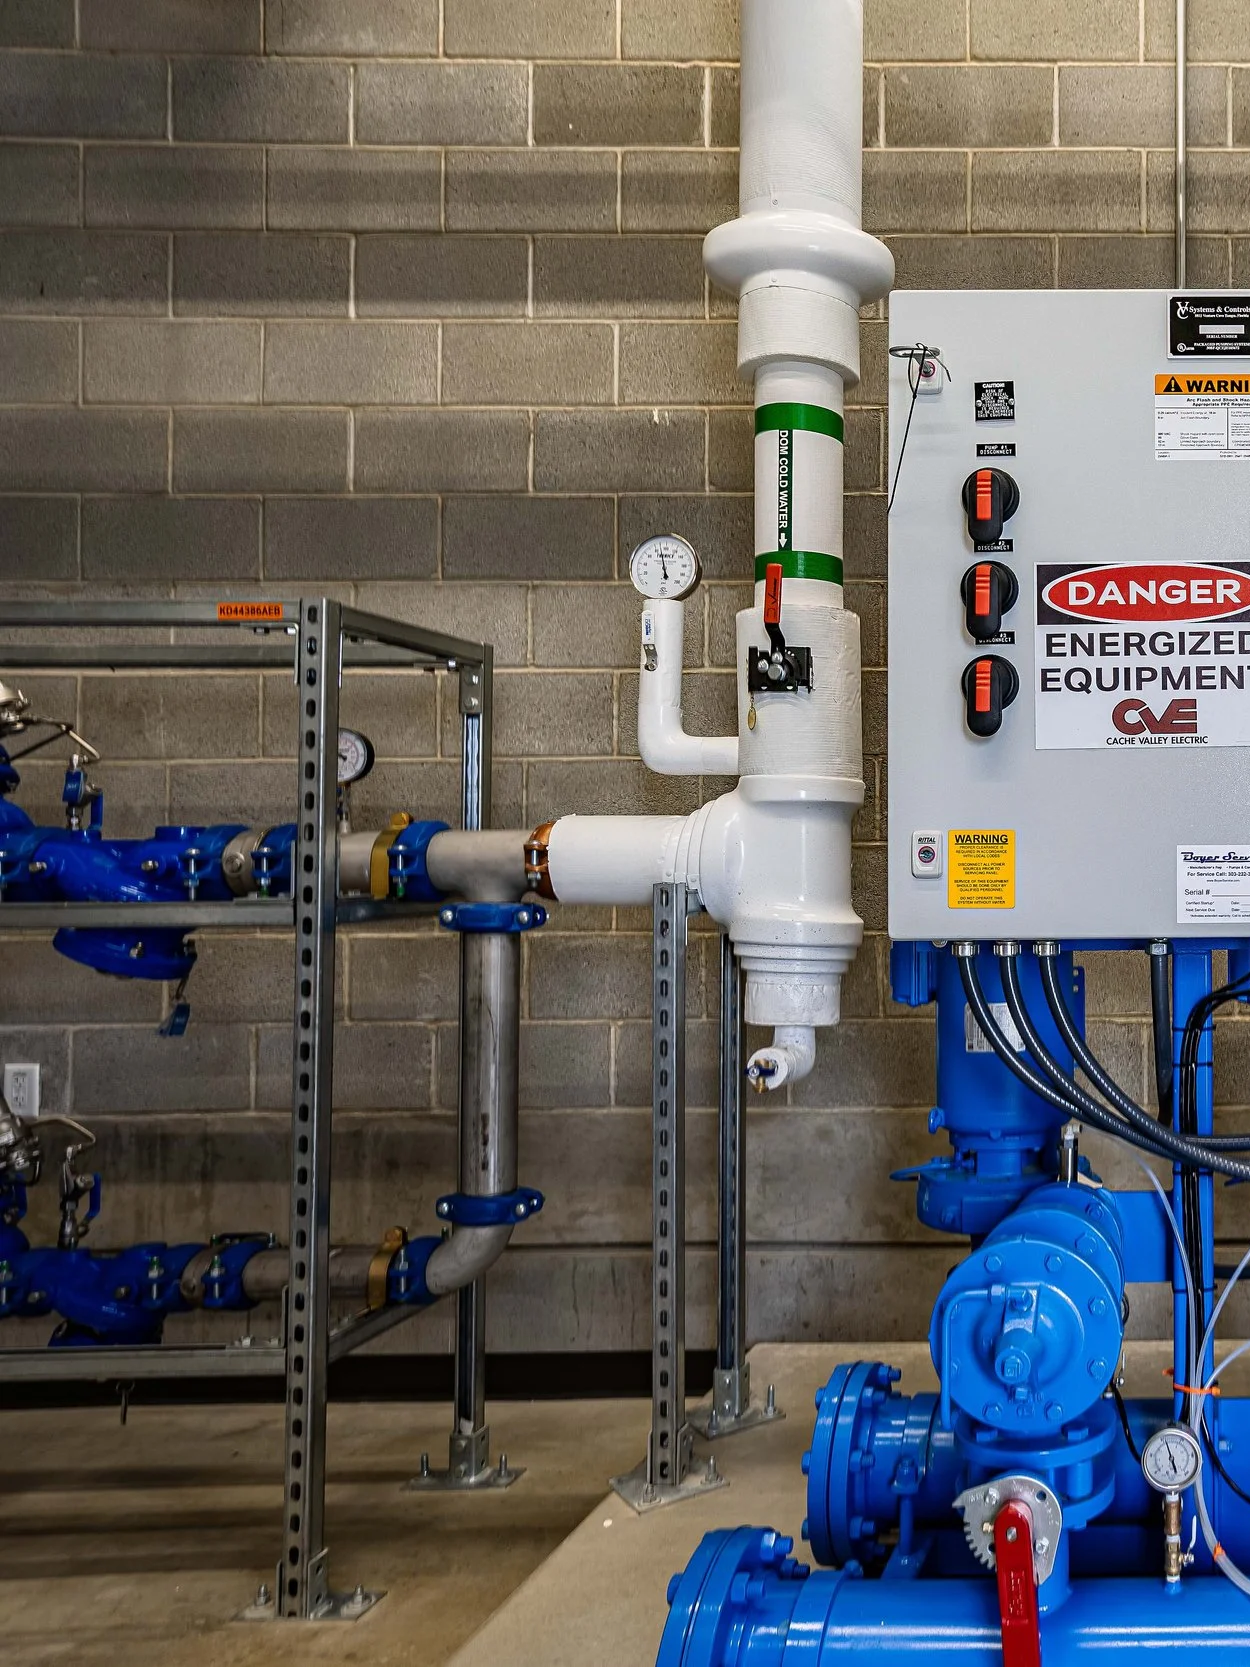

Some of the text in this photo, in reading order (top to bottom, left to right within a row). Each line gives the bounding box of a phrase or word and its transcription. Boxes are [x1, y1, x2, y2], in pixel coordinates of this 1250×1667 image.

[1189, 306, 1215, 314] Systems
[779, 430, 789, 529] DOM COLD WATER
[1068, 579, 1241, 605] DANGER
[1112, 698, 1197, 735] CVE
[1106, 735, 1208, 745] CACHE VALLEY ELECTRIC
[954, 835, 1009, 843] WARNING
[1180, 852, 1220, 863] Boyer
